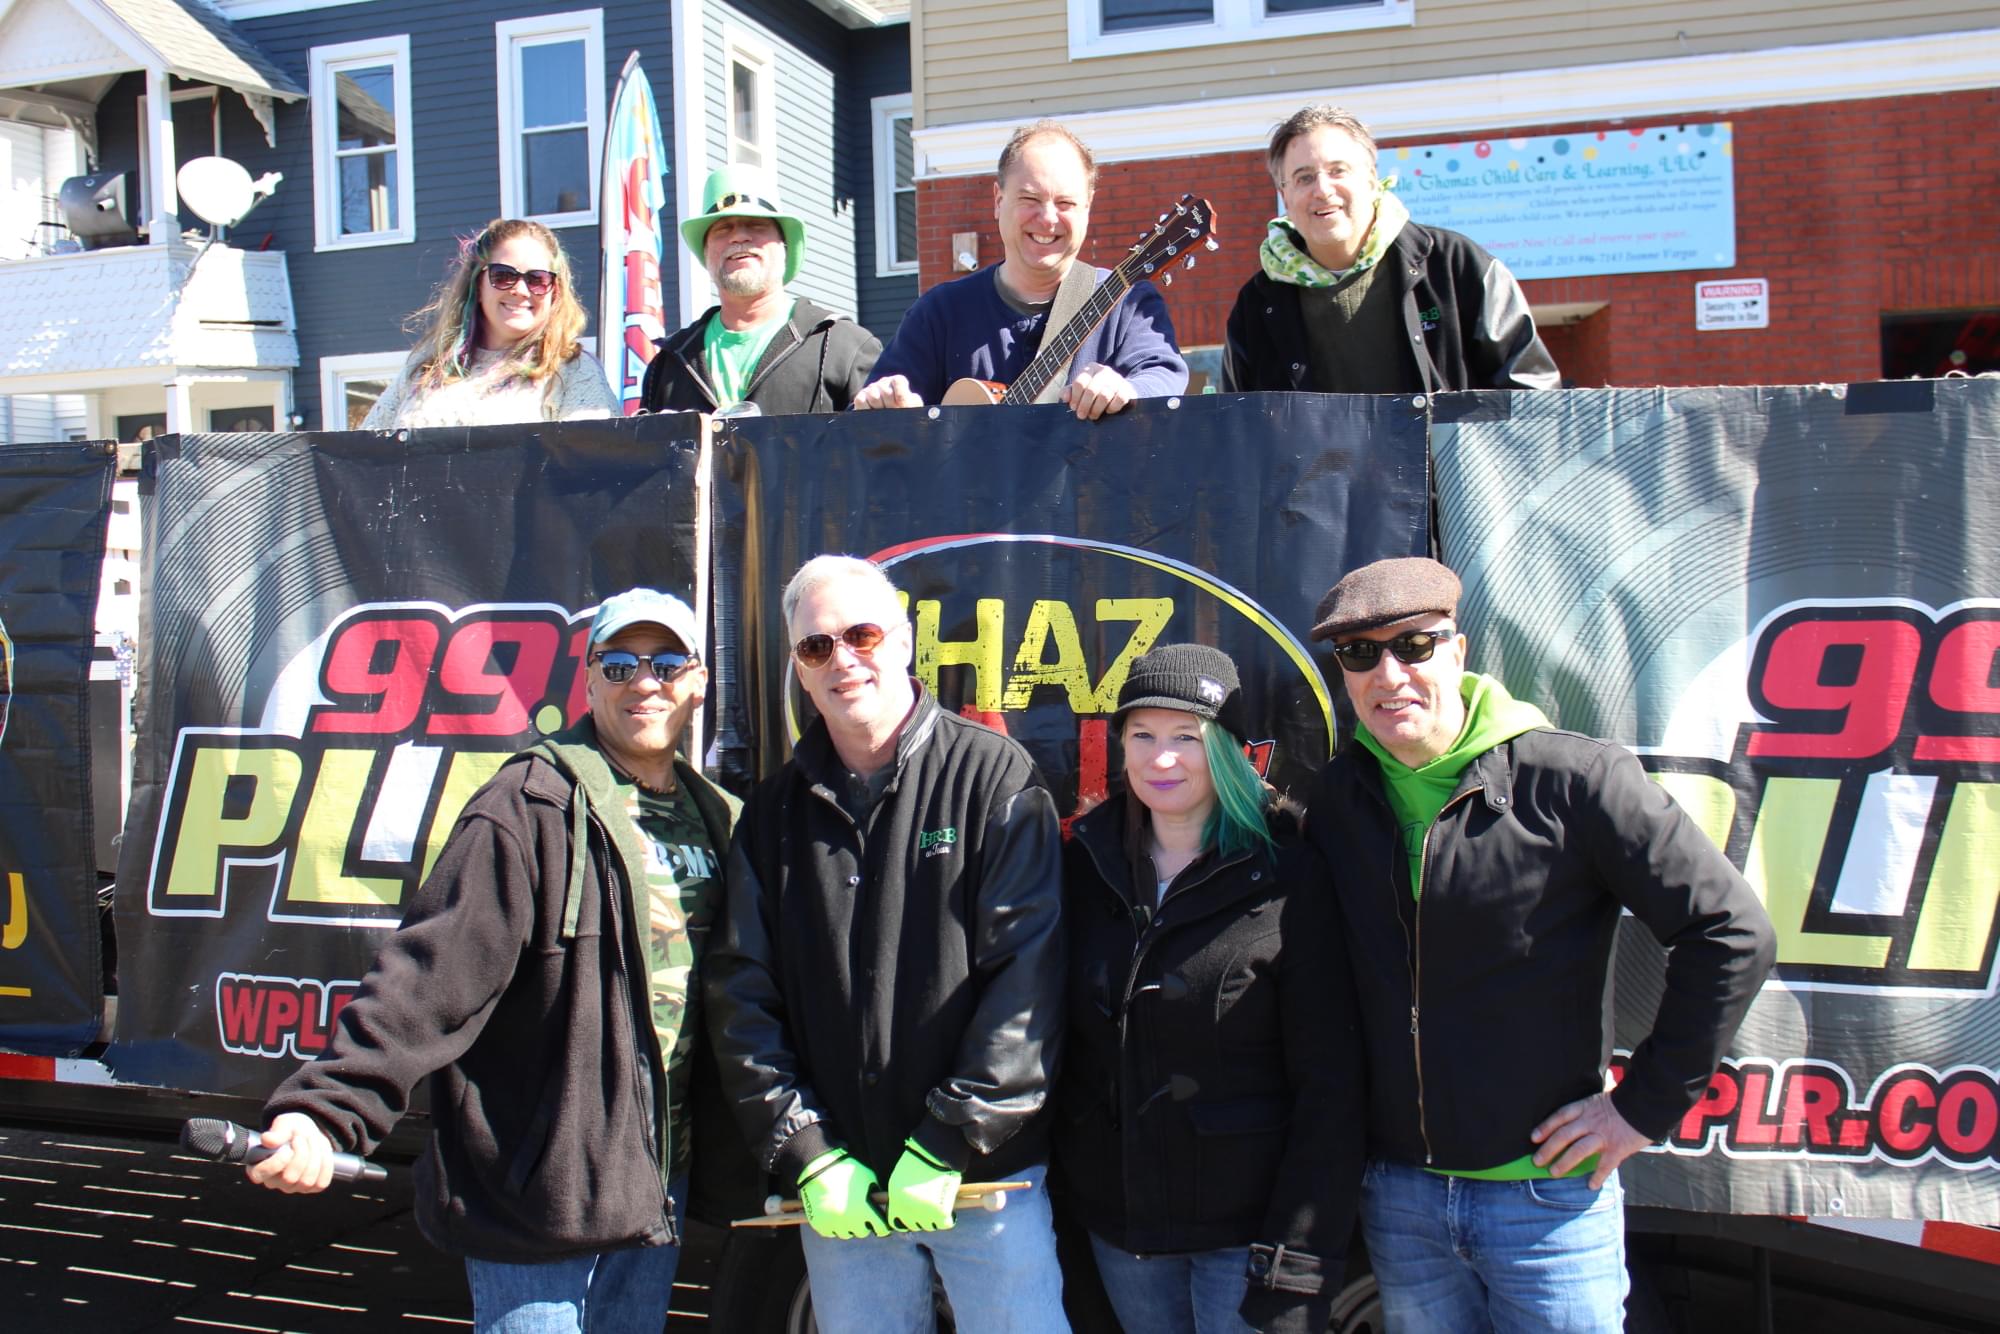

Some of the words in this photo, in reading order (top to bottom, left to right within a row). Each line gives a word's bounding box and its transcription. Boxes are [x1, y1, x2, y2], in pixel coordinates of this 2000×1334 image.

[1418, 171, 1477, 190] Thomas
[1480, 168, 1520, 185] Child
[1523, 165, 1557, 182] Care
[1561, 165, 1576, 179] &
[1658, 154, 1702, 173] LLC
[1702, 285, 1761, 297] WARNING
[896, 590, 1174, 713] HAZ
